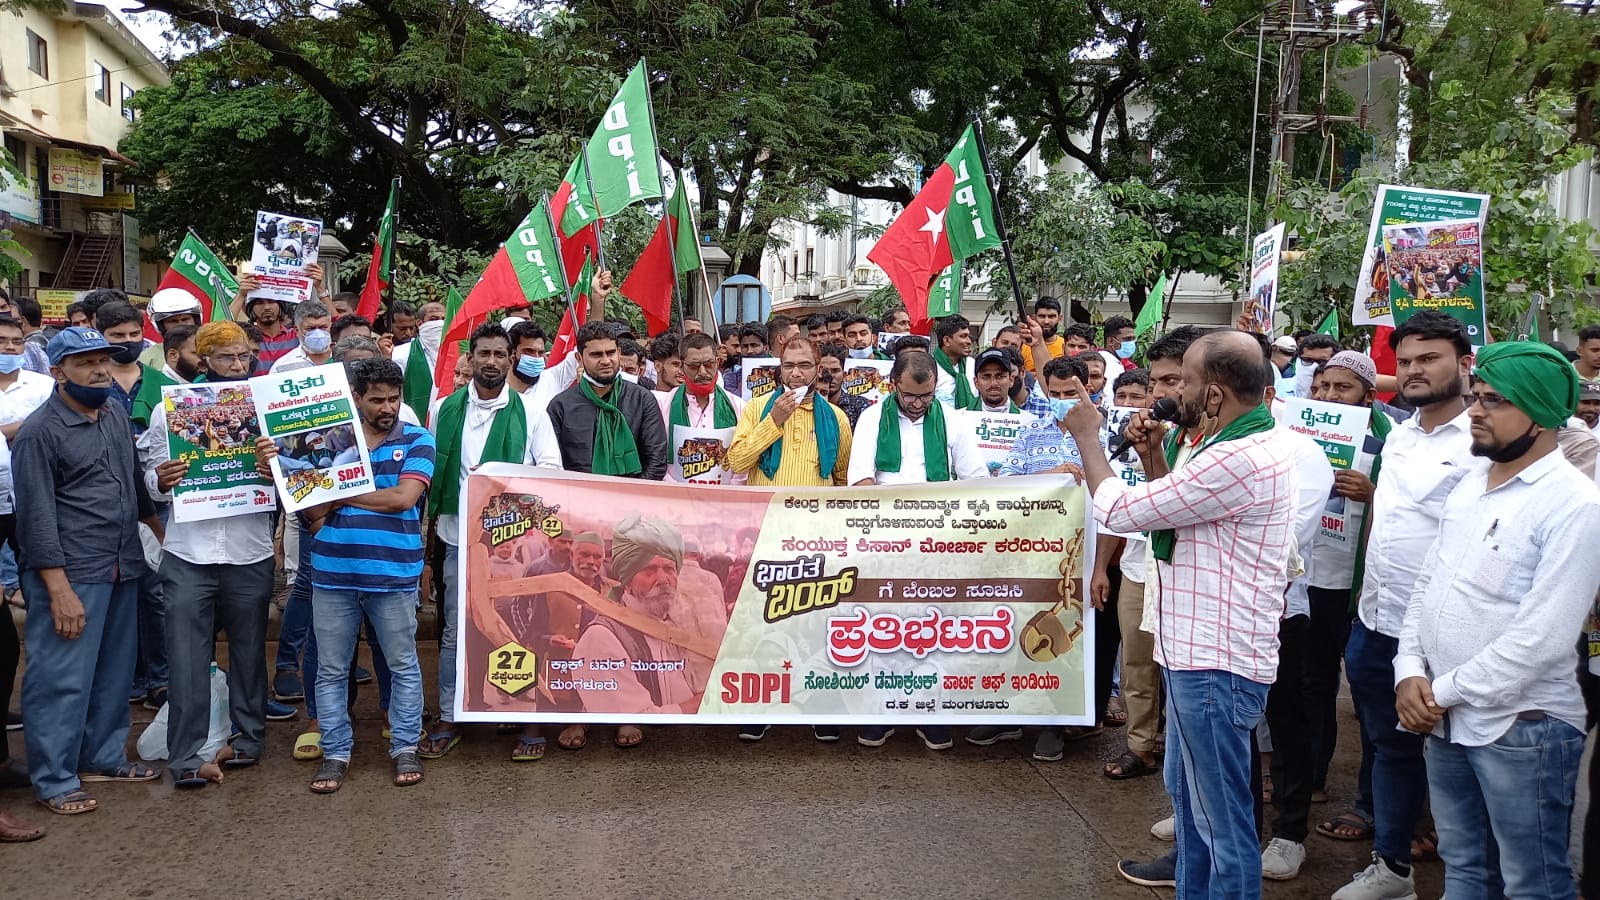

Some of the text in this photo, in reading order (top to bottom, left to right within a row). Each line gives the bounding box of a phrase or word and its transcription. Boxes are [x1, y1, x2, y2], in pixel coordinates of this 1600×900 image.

[1395, 297, 1409, 311] ಕೃಷಿ
[279, 374, 326, 397] ರೈತರ
[1300, 408, 1343, 427] ರೈತರ
[202, 460, 243, 472] ಕೂಡಲೇ
[337, 462, 365, 482] SDPI
[683, 457, 716, 479] ಬಂದ್
[784, 496, 1068, 517] ಕೇಂದ್ರ ಸರ್ಕಾರದ ವಿವಾದಾತ್ಮಕ ಕೃಷಿ ಕಾಯ್ದೆಗಳನ್ನು
[491, 516, 532, 546] ಬಂದ್
[545, 519, 558, 528] 27
[951, 517, 1008, 535] ಒತ್ತಾಯಿಸಿ
[1321, 516, 1344, 532] SDPI
[781, 536, 1064, 557] ಸಂಯುಕ್ತ ಕಿಸಾನ್ ಮೋರ್ಚಾ ಕರೆದಿರುವ
[754, 557, 822, 585] ಭಾರತ
[769, 570, 855, 619] ಬಂದ್
[878, 582, 1023, 599] ಗೆ ಬೆಂಬಲ ಸೂಚಿಸಿ
[828, 607, 1014, 664] ಪ್ರತಿಭಟನೆ
[497, 651, 526, 670] 27
[550, 659, 685, 674] ಕ್ಲಾಕ್ ಟವರ್ ಮುಂಭಾಗ
[491, 671, 533, 686] ಸೆಪ್ಟೆಂಬರ್
[550, 680, 618, 691] ಮಂಗಳೂರು
[720, 660, 793, 704] SDPI
[804, 671, 1060, 695] ಸೋಶಿಯಲ್ ಡೆಮಾಕ್ರಟಿಕ್ ಪಾರ್ಟಿ ಆಫ್ ಇಂಡಿಯಾ
[915, 699, 937, 713] ಜಿಲ್ಲೆ
[941, 700, 1010, 712] ಮಂಗಳೂರು
